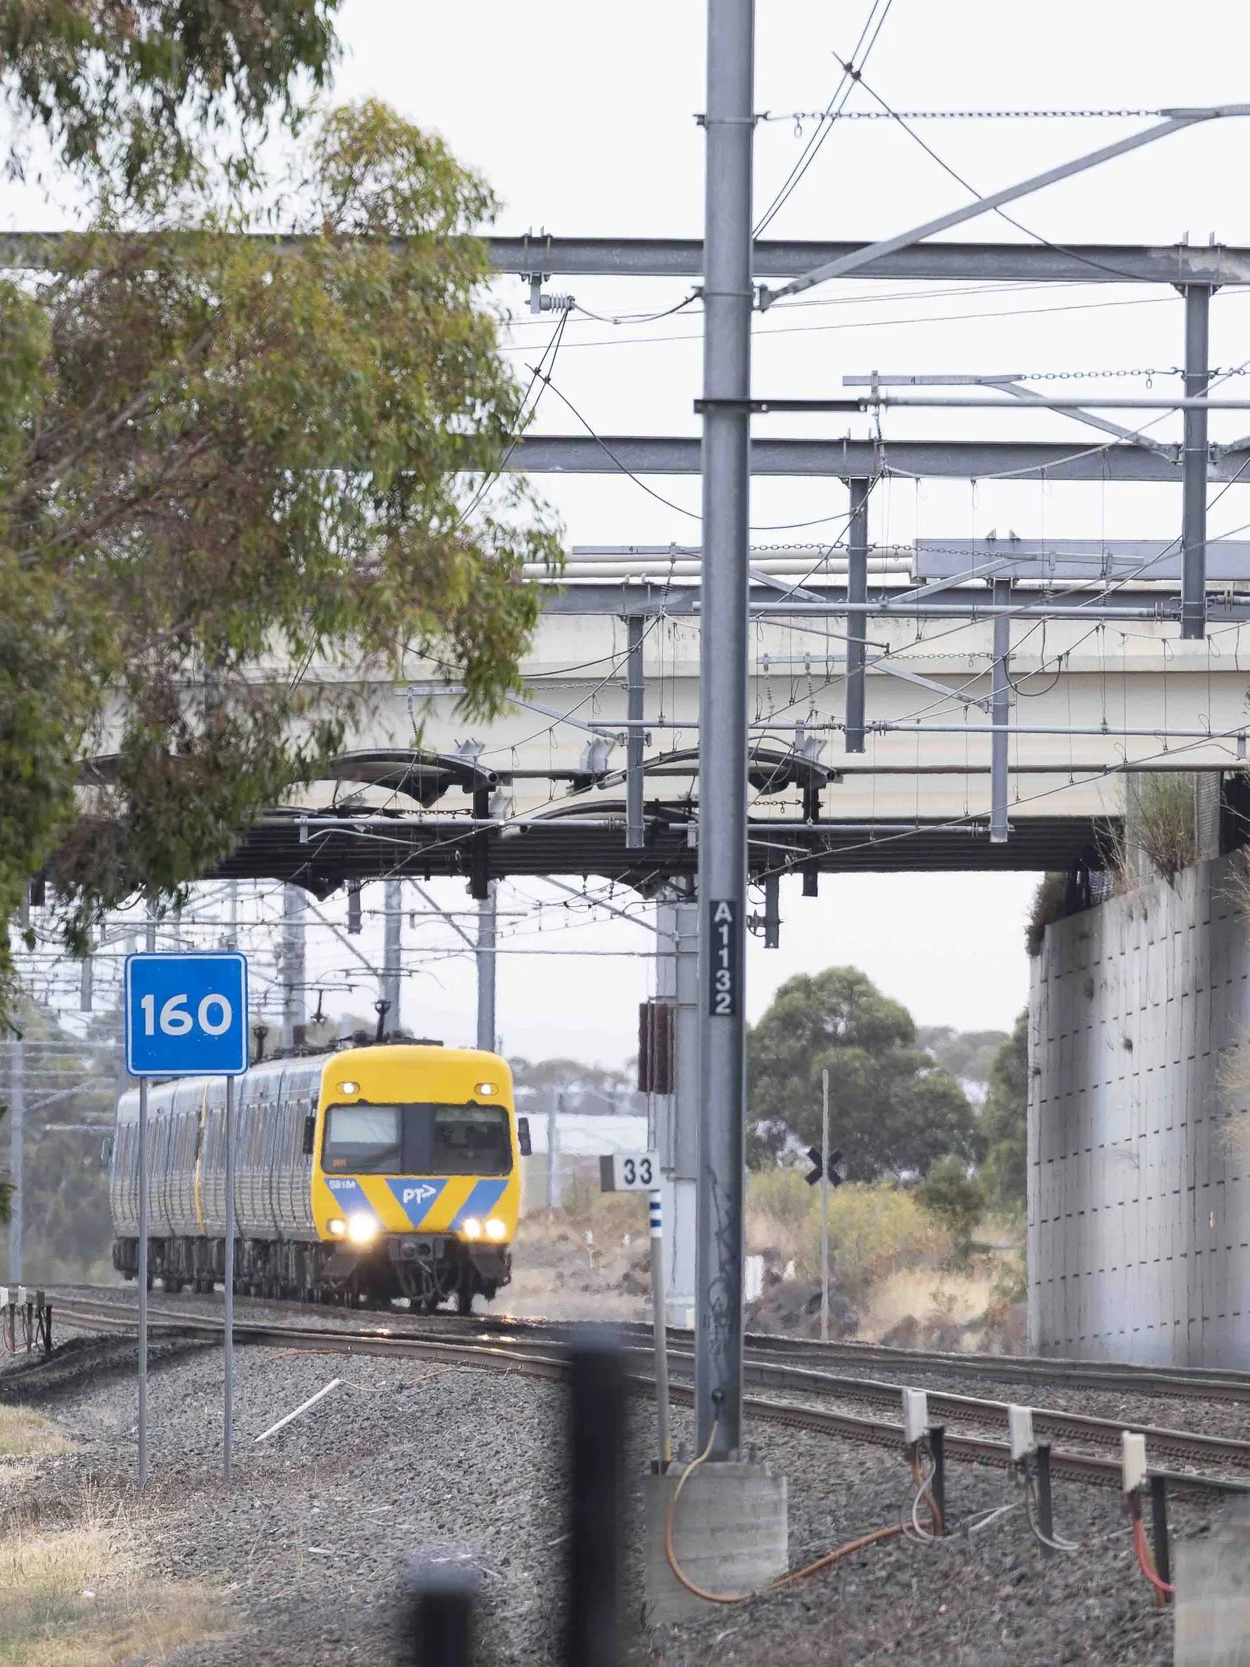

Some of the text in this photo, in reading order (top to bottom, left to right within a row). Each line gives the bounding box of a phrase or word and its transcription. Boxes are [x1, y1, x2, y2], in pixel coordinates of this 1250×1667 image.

[713, 901, 733, 1015] A1132
[141, 993, 232, 1036] 160
[624, 1158, 652, 1185] 33
